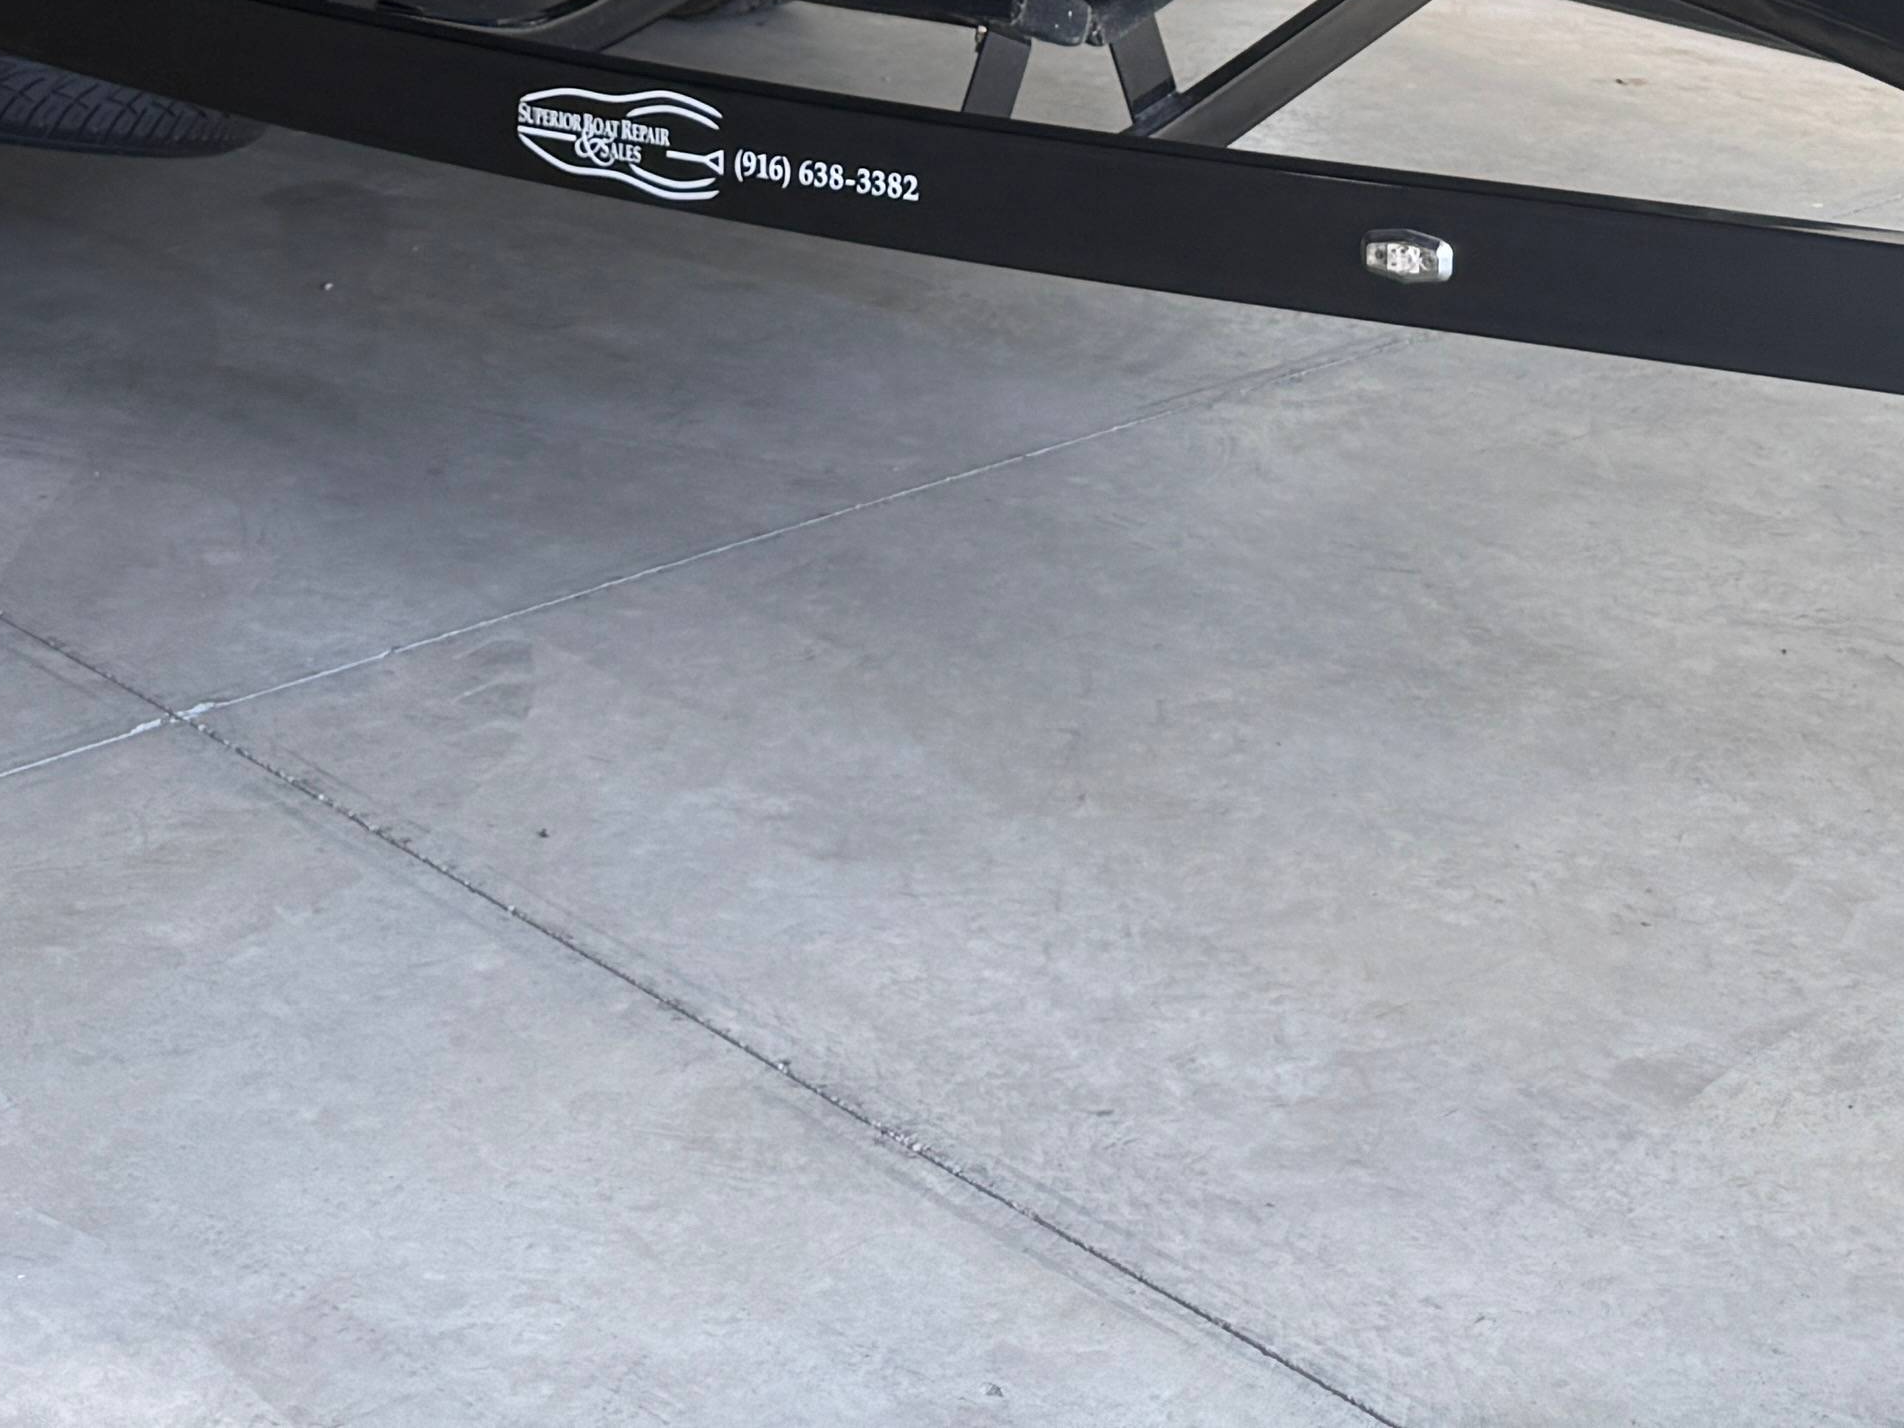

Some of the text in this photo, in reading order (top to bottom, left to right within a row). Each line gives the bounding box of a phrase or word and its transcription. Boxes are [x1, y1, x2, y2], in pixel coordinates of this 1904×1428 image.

[518, 102, 671, 148] SUPERIOR BOAT REPAIR
[601, 140, 643, 164] SALES
[733, 149, 920, 202] (916) 638-3382
